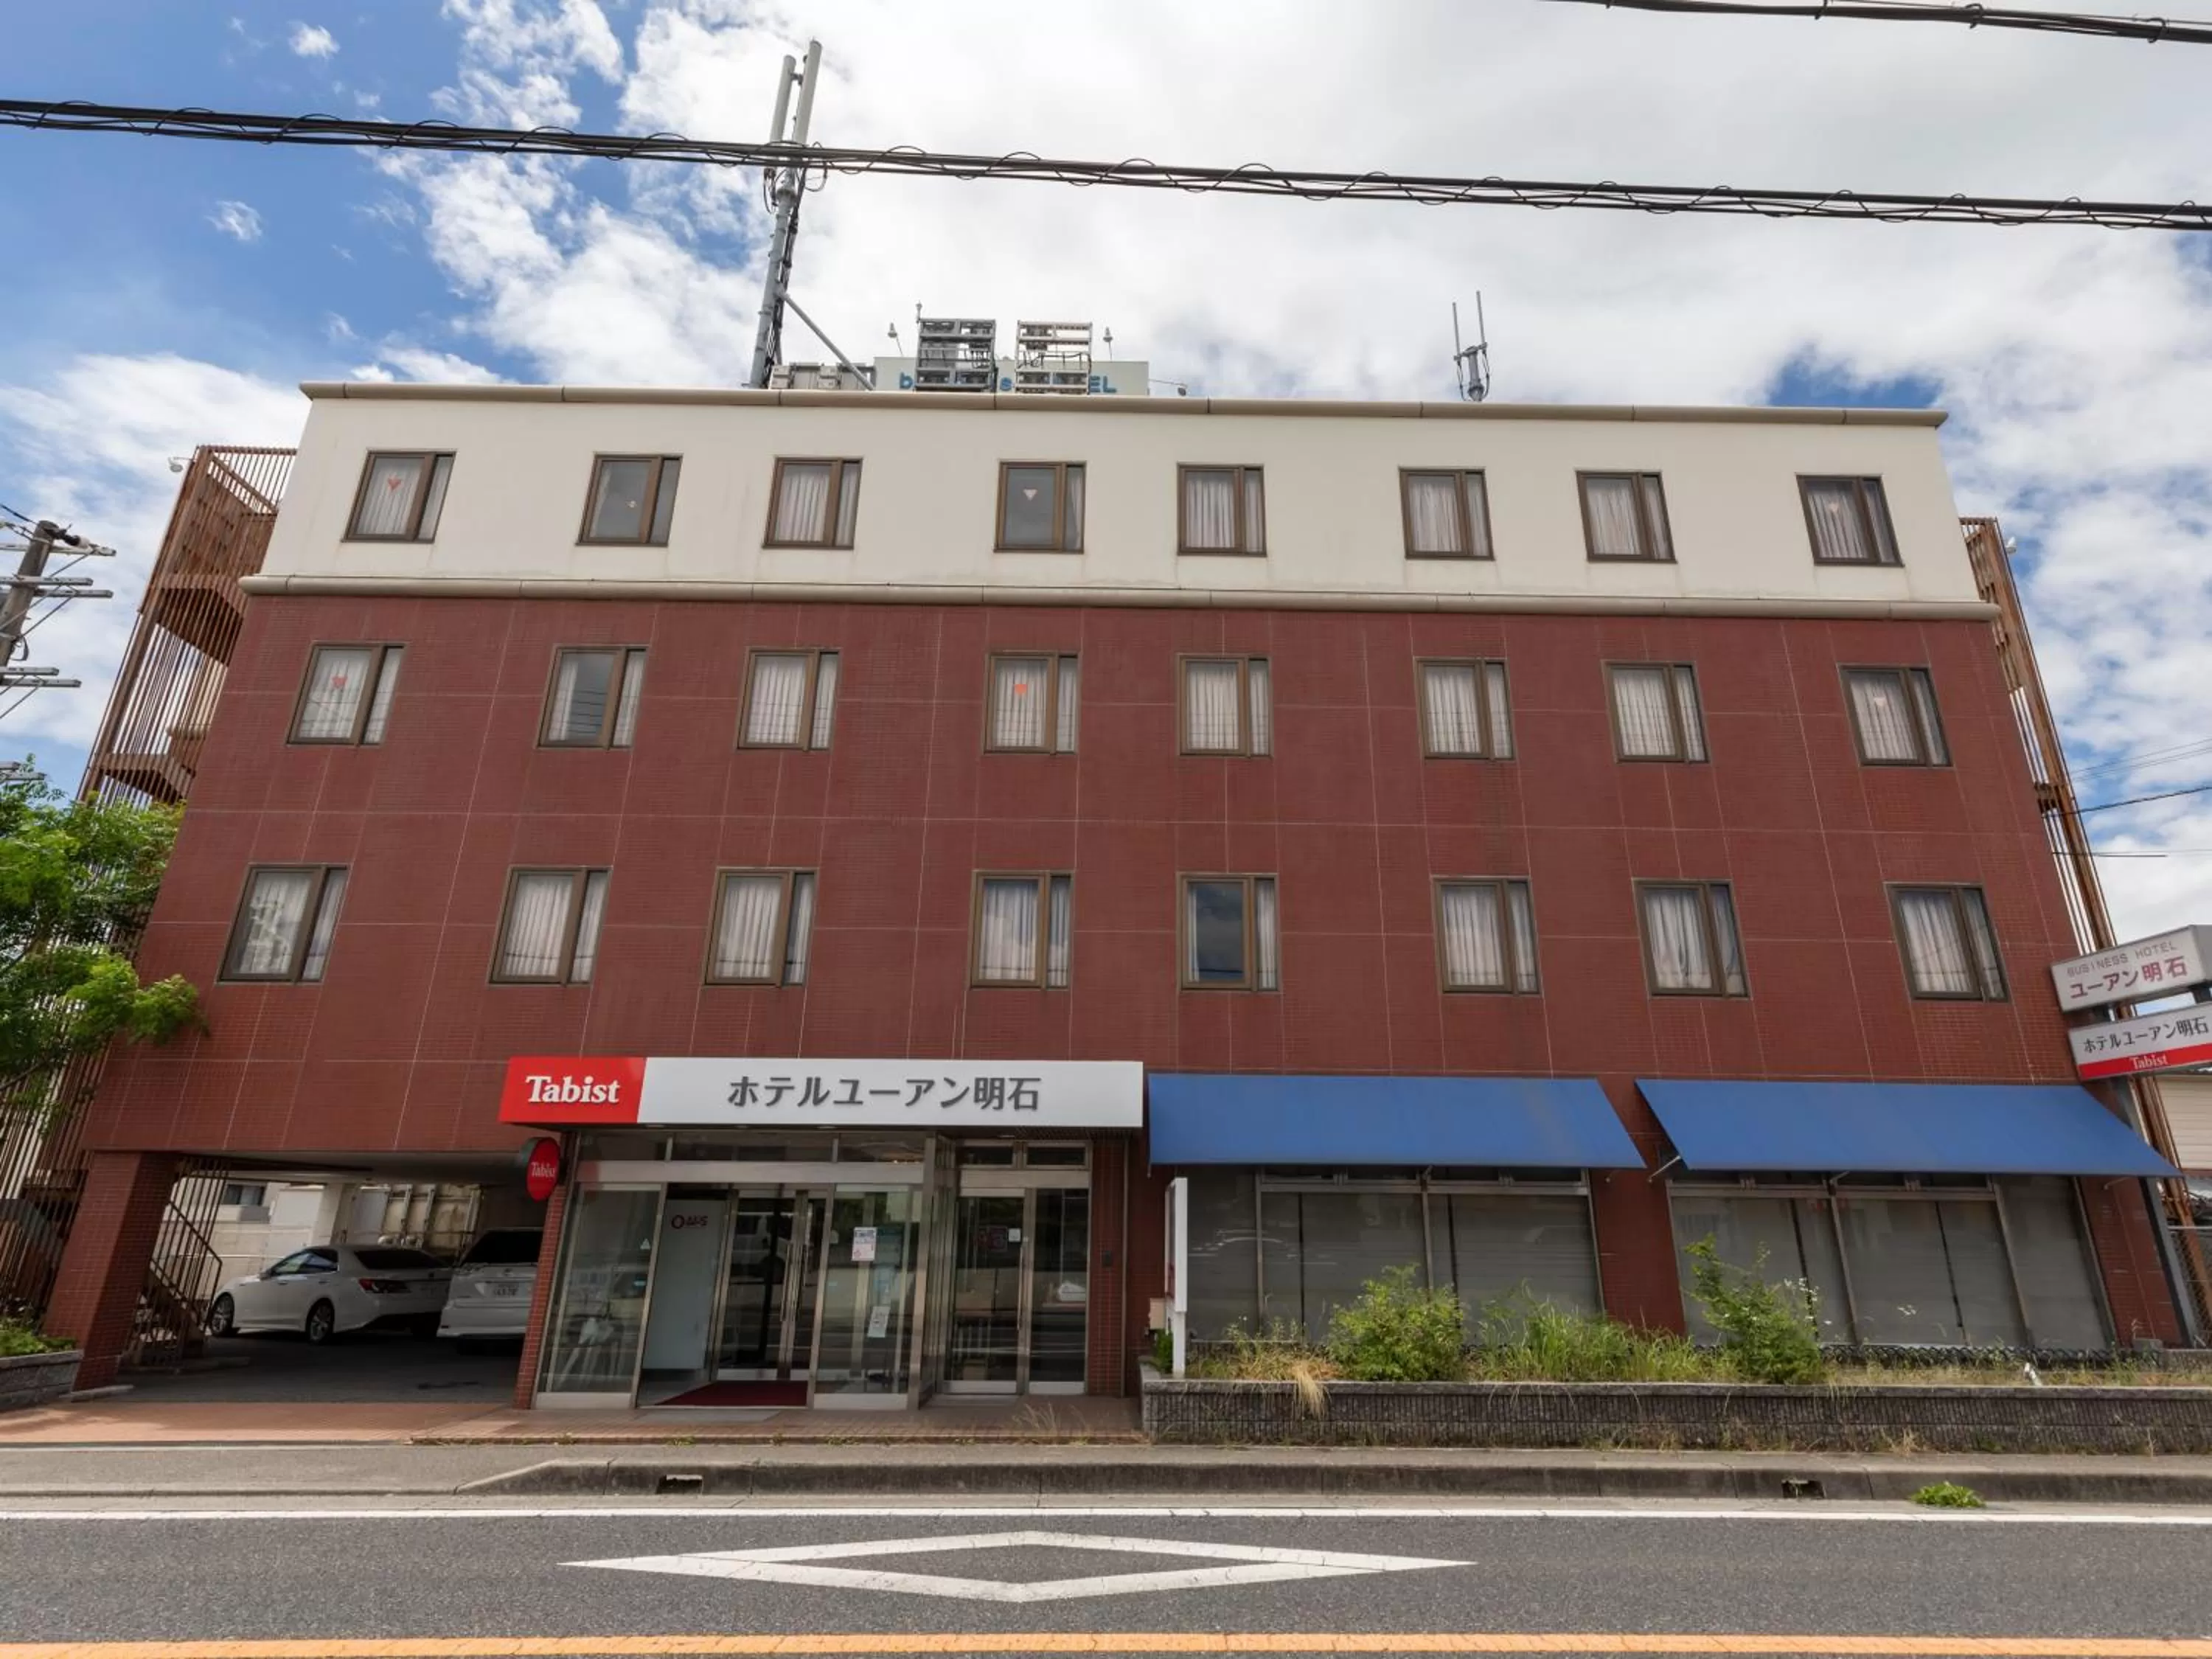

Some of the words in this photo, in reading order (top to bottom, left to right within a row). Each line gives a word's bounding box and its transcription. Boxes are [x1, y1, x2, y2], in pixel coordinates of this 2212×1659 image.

[2067, 953, 2128, 978] BUSINESS
[2135, 941, 2177, 960] HOTEL
[2070, 956, 2188, 998] ユーアン明石
[2083, 1016, 2209, 1053] ホテルユーアン明石
[2129, 1054, 2168, 1070] Tabist
[525, 1075, 620, 1103] Tabist
[728, 1076, 1042, 1111] ホテルユーアン明石
